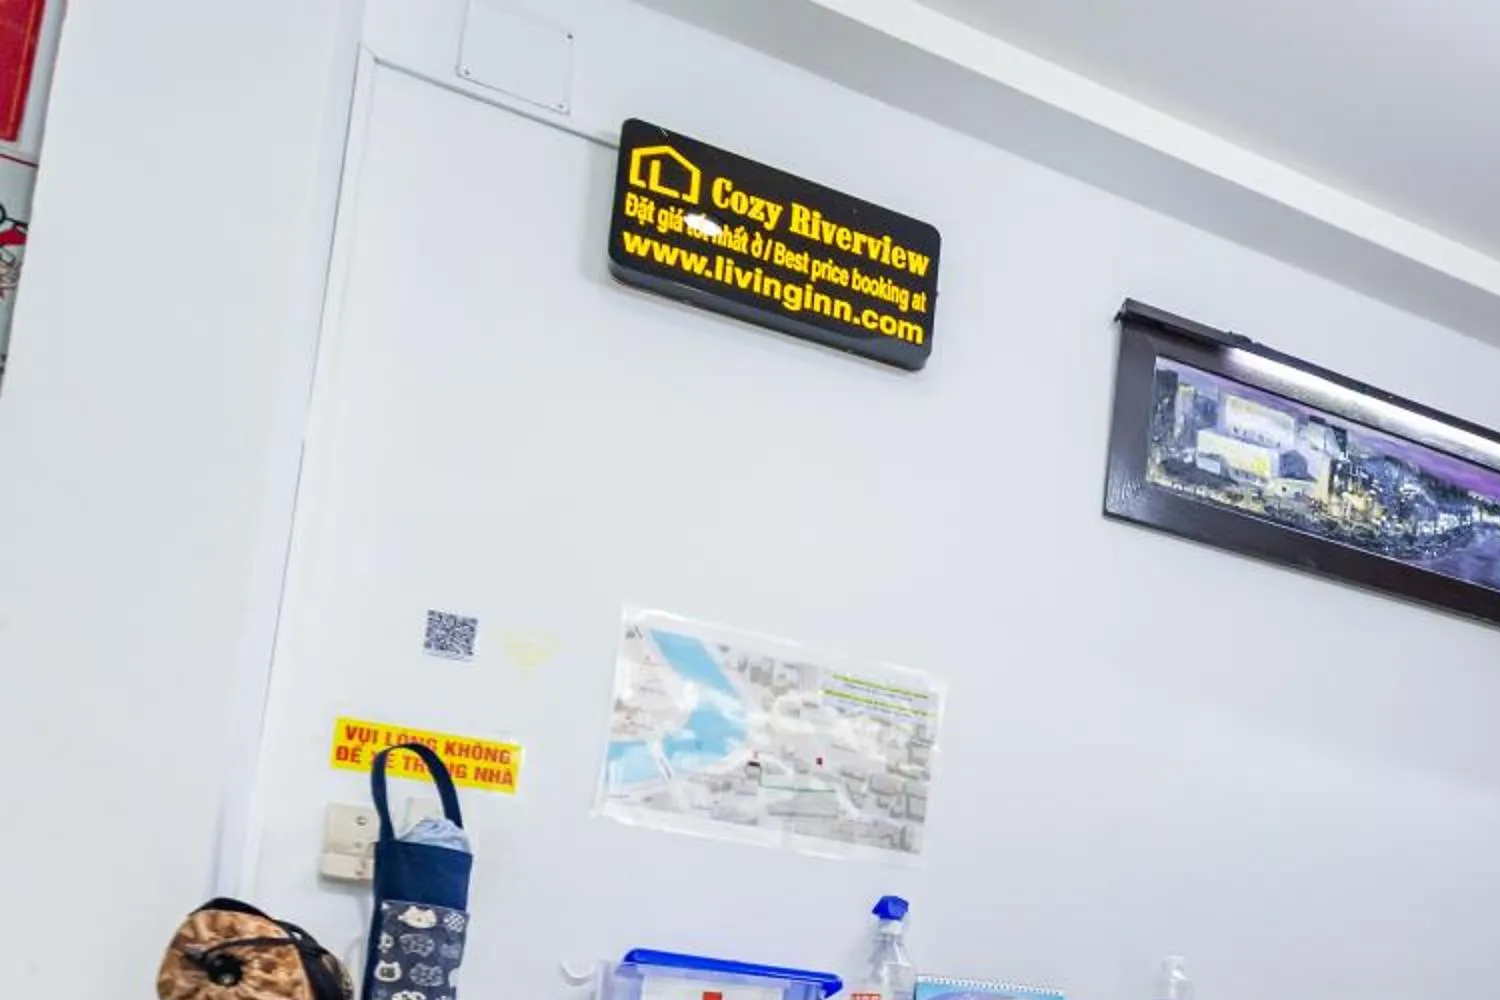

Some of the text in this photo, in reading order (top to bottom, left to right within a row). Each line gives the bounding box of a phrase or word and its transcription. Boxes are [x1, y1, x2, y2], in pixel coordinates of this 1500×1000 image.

[657, 206, 684, 233] giá
[774, 242, 810, 275] Best
[811, 259, 849, 287] price
[852, 268, 909, 312] booking
[911, 292, 926, 313] at
[713, 178, 783, 230] Cozy
[790, 204, 929, 276] Riverview
[623, 232, 923, 344] www.livinginn.com
[372, 752, 396, 769] E
[403, 756, 466, 779] TRG
[445, 741, 511, 765] KHÔNG
